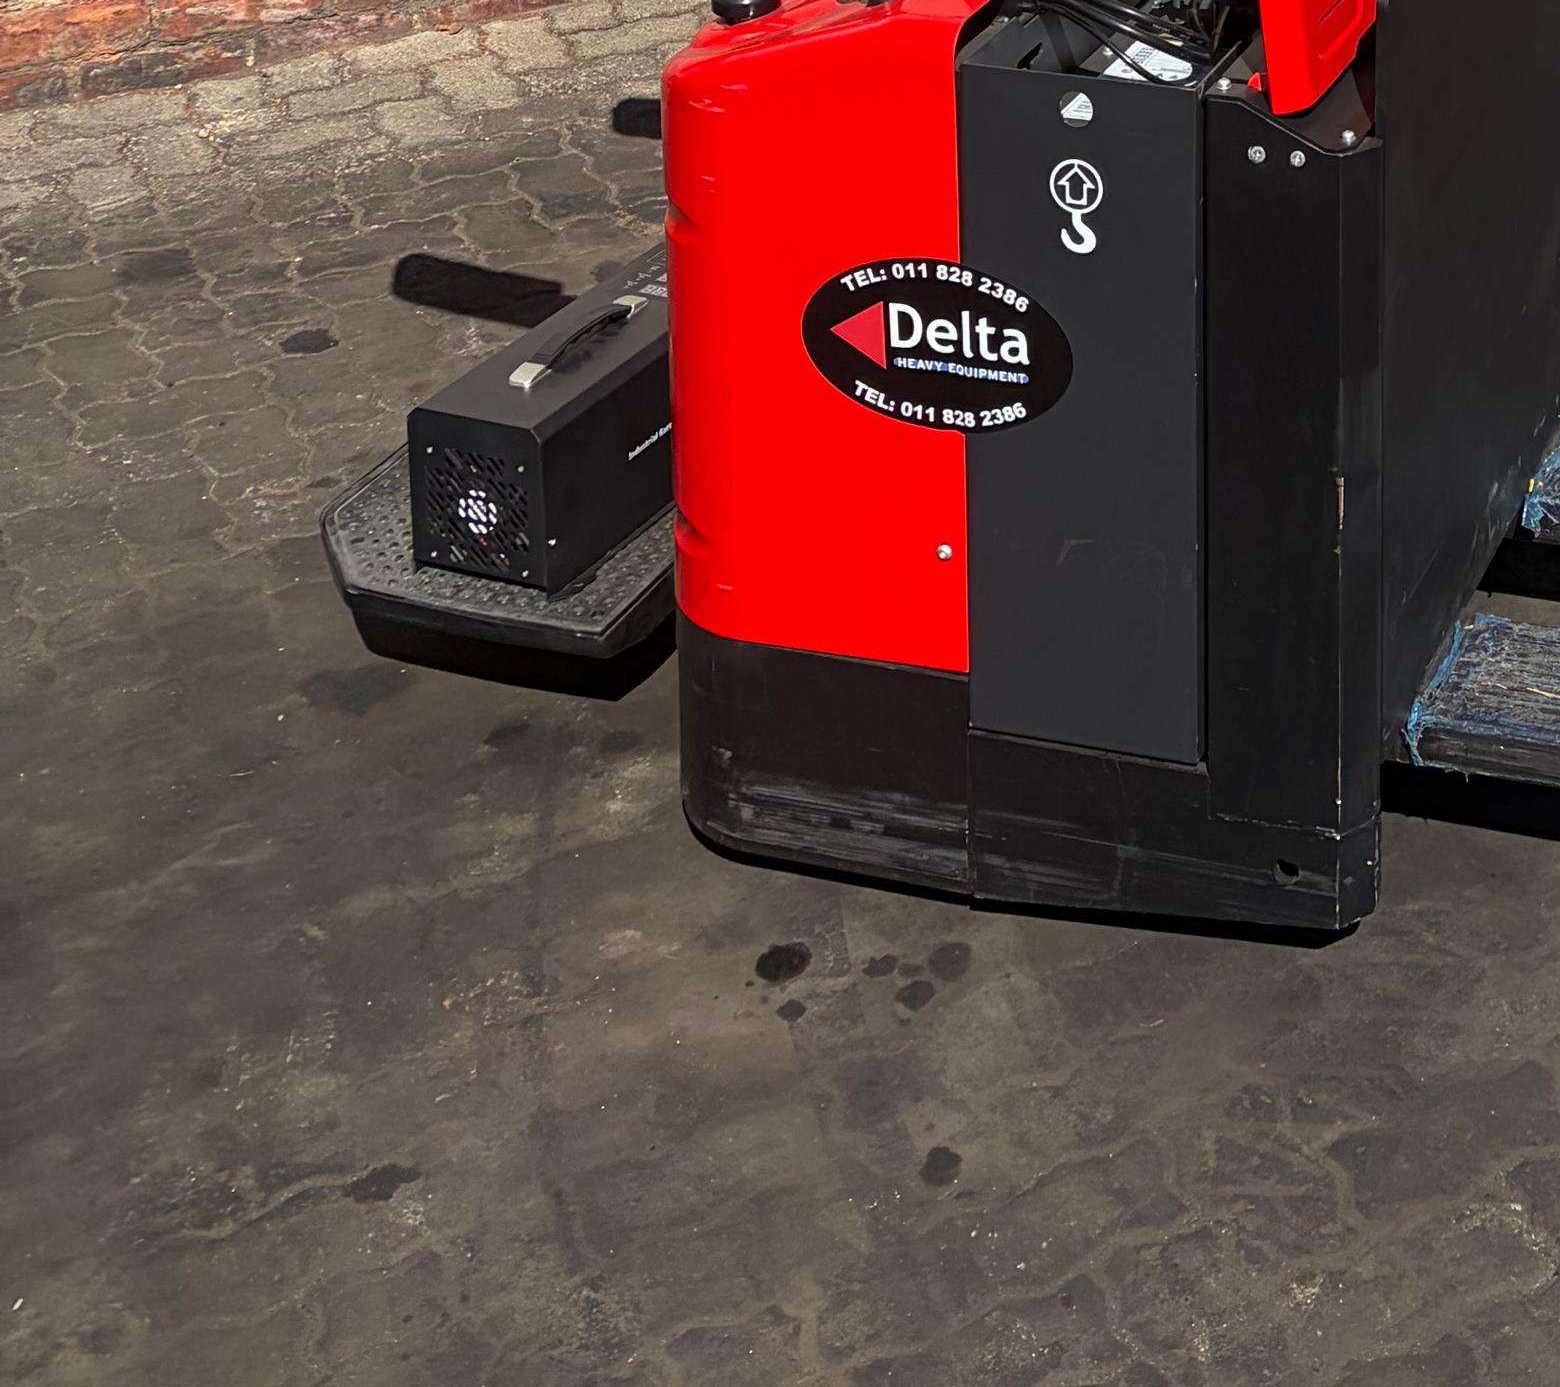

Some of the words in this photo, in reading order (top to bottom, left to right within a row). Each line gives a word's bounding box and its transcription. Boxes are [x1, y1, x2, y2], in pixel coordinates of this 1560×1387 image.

[840, 267, 888, 293] TEL:
[891, 262, 928, 279] 011
[935, 263, 974, 287] 828
[977, 276, 1030, 314] 2386
[888, 301, 1031, 365] Delta
[896, 356, 943, 372] HEAVY
[948, 362, 1028, 385] EQUIPMENT
[853, 379, 896, 412] TEL:
[900, 401, 935, 422] 011
[942, 408, 976, 428] 828
[979, 402, 1027, 427] 2386
